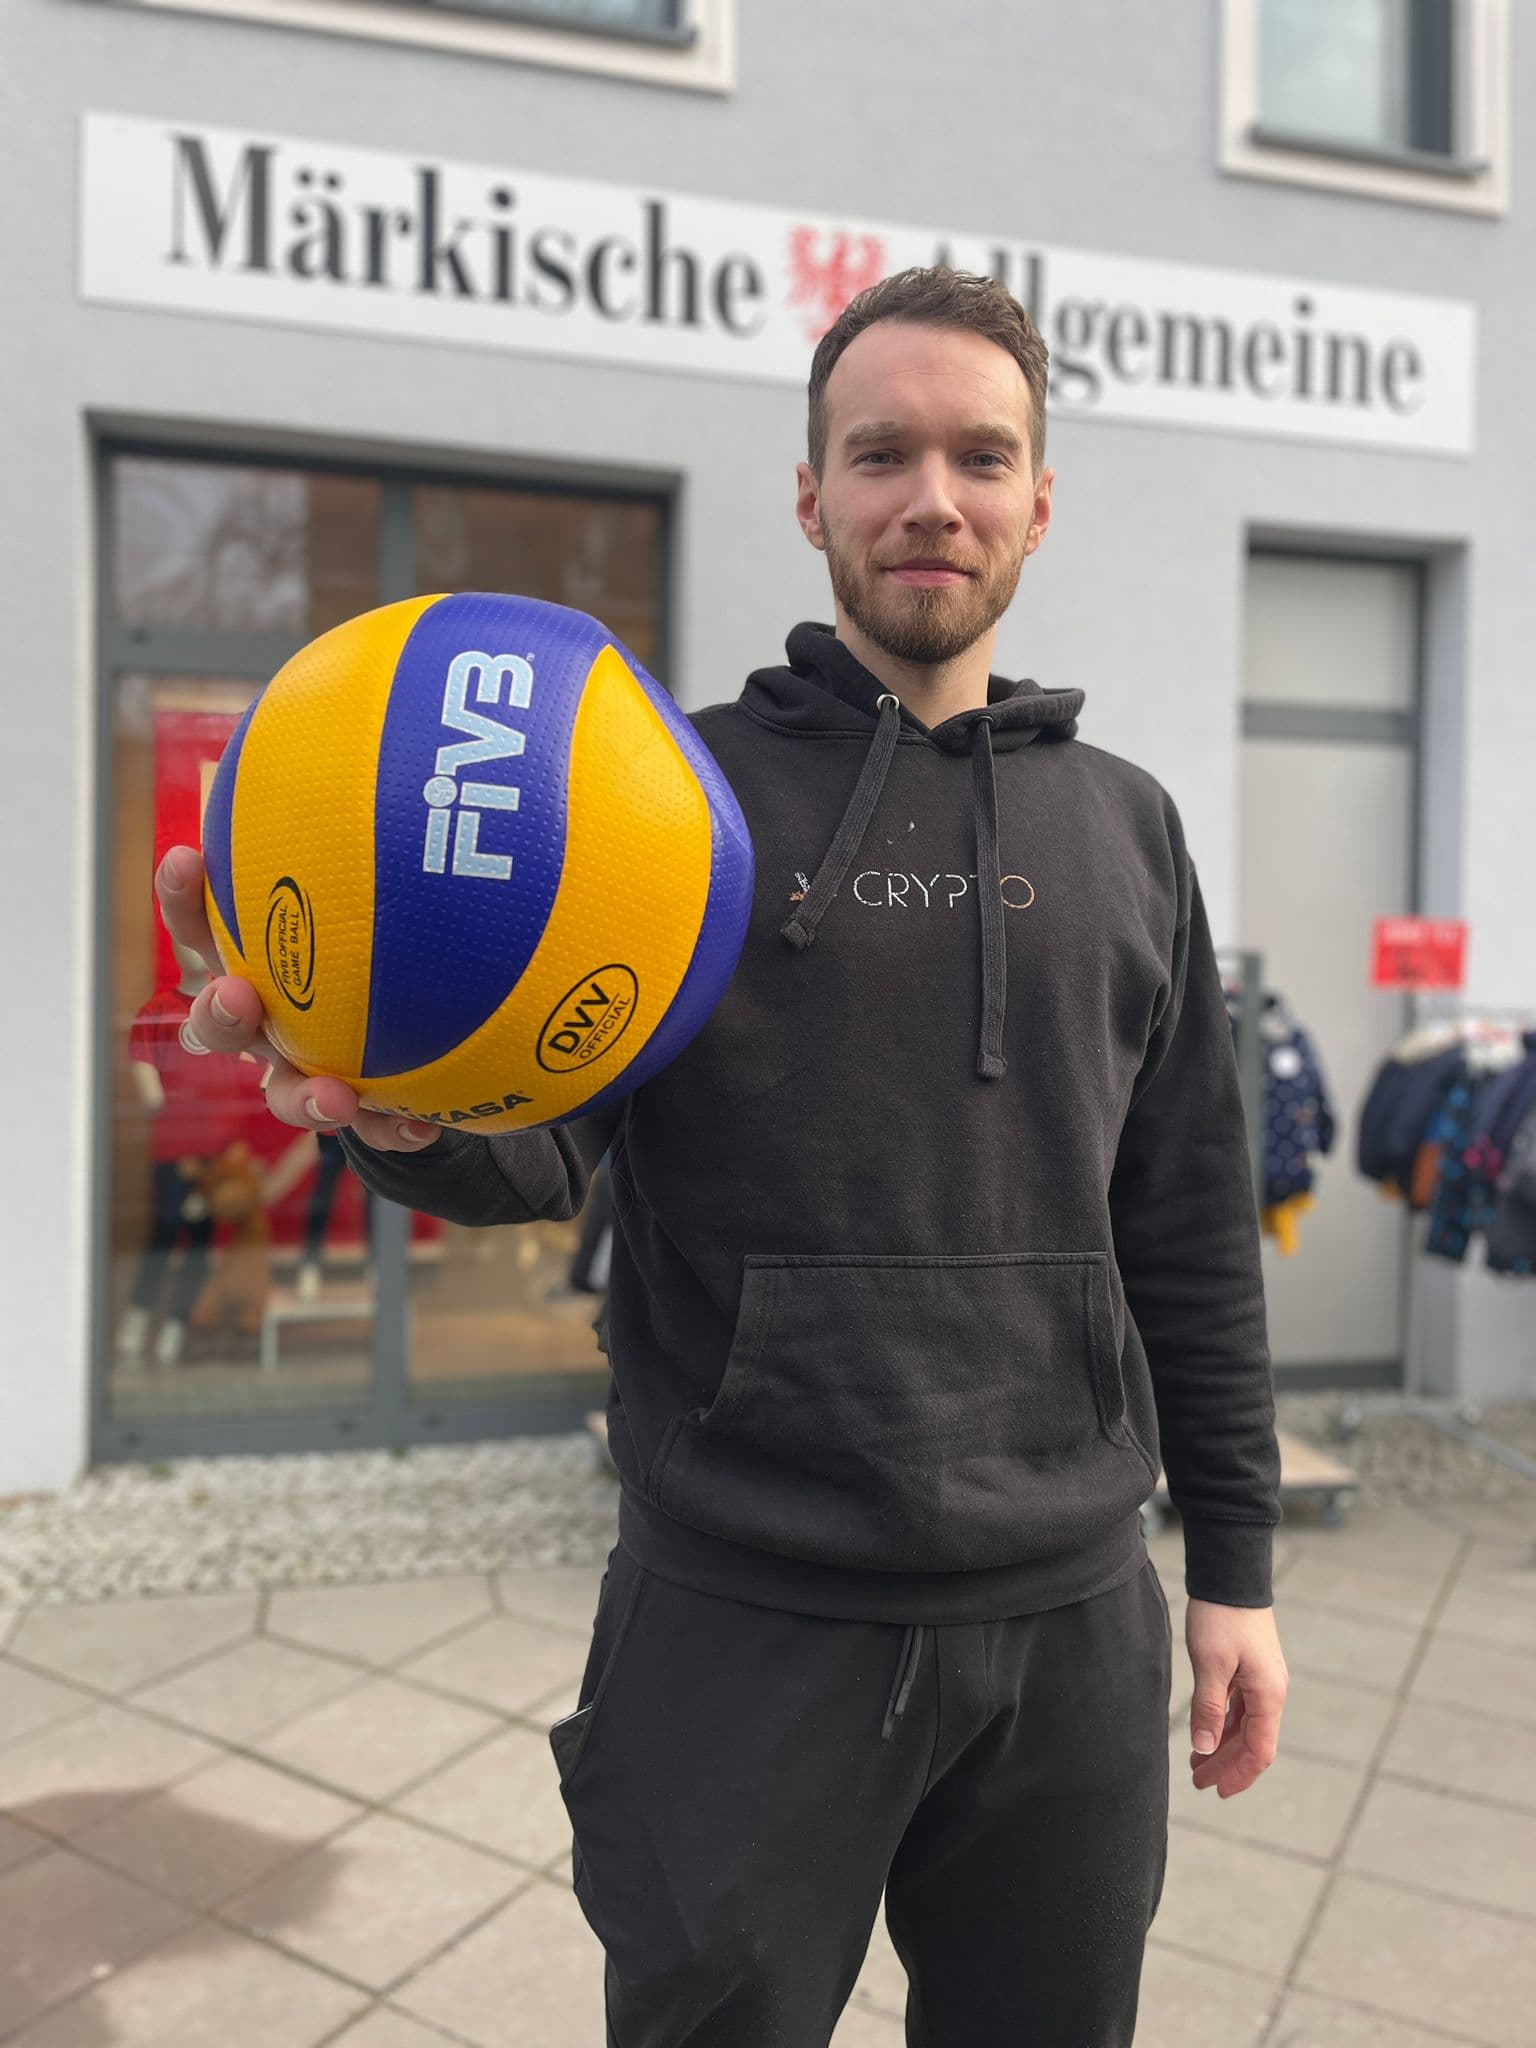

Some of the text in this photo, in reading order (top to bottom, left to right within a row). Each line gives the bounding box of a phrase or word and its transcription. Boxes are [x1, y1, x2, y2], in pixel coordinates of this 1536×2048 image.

[163, 132, 1425, 416] Märkische lgemeine
[853, 870, 1035, 910] CRYPO
[277, 905, 290, 985] FIVB OFFICIAL
[289, 911, 302, 986] GAME BALL
[547, 982, 610, 1054] DVV
[580, 997, 632, 1059] OFFICIAL
[373, 1092, 535, 1124] KASA
